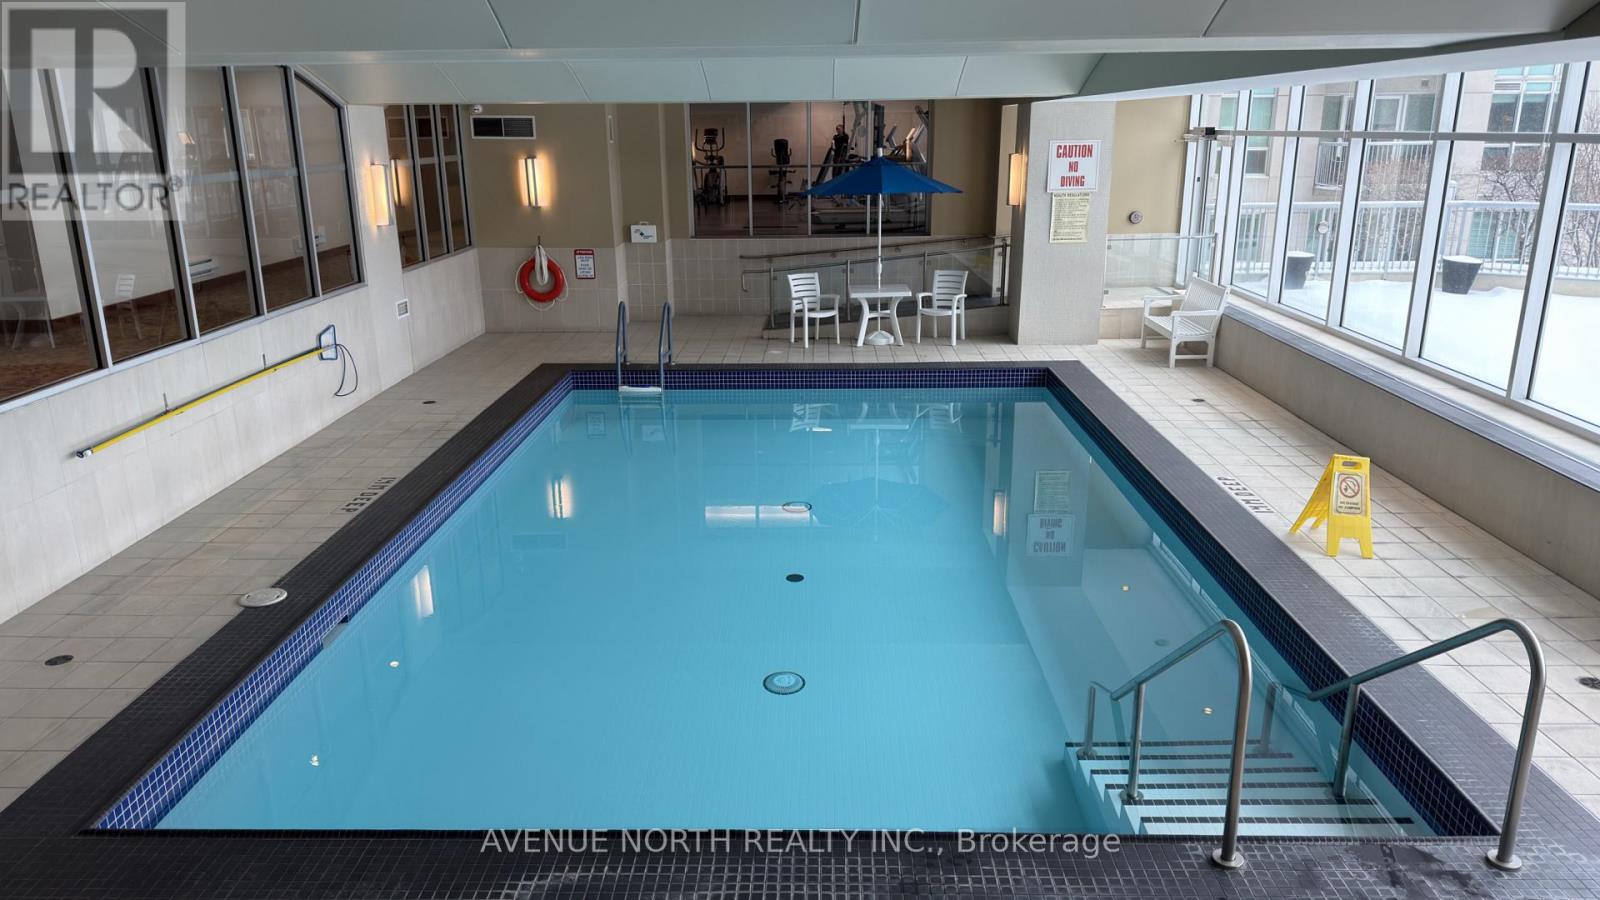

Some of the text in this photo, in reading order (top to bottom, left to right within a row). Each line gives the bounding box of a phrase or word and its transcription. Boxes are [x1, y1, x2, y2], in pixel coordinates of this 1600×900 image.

[1056, 144, 1093, 158] CAUTION
[1068, 161, 1079, 172] NO
[1060, 176, 1085, 187] DIVING
[1216, 476, 1256, 497] DEEP
[341, 492, 378, 512] DEEP
